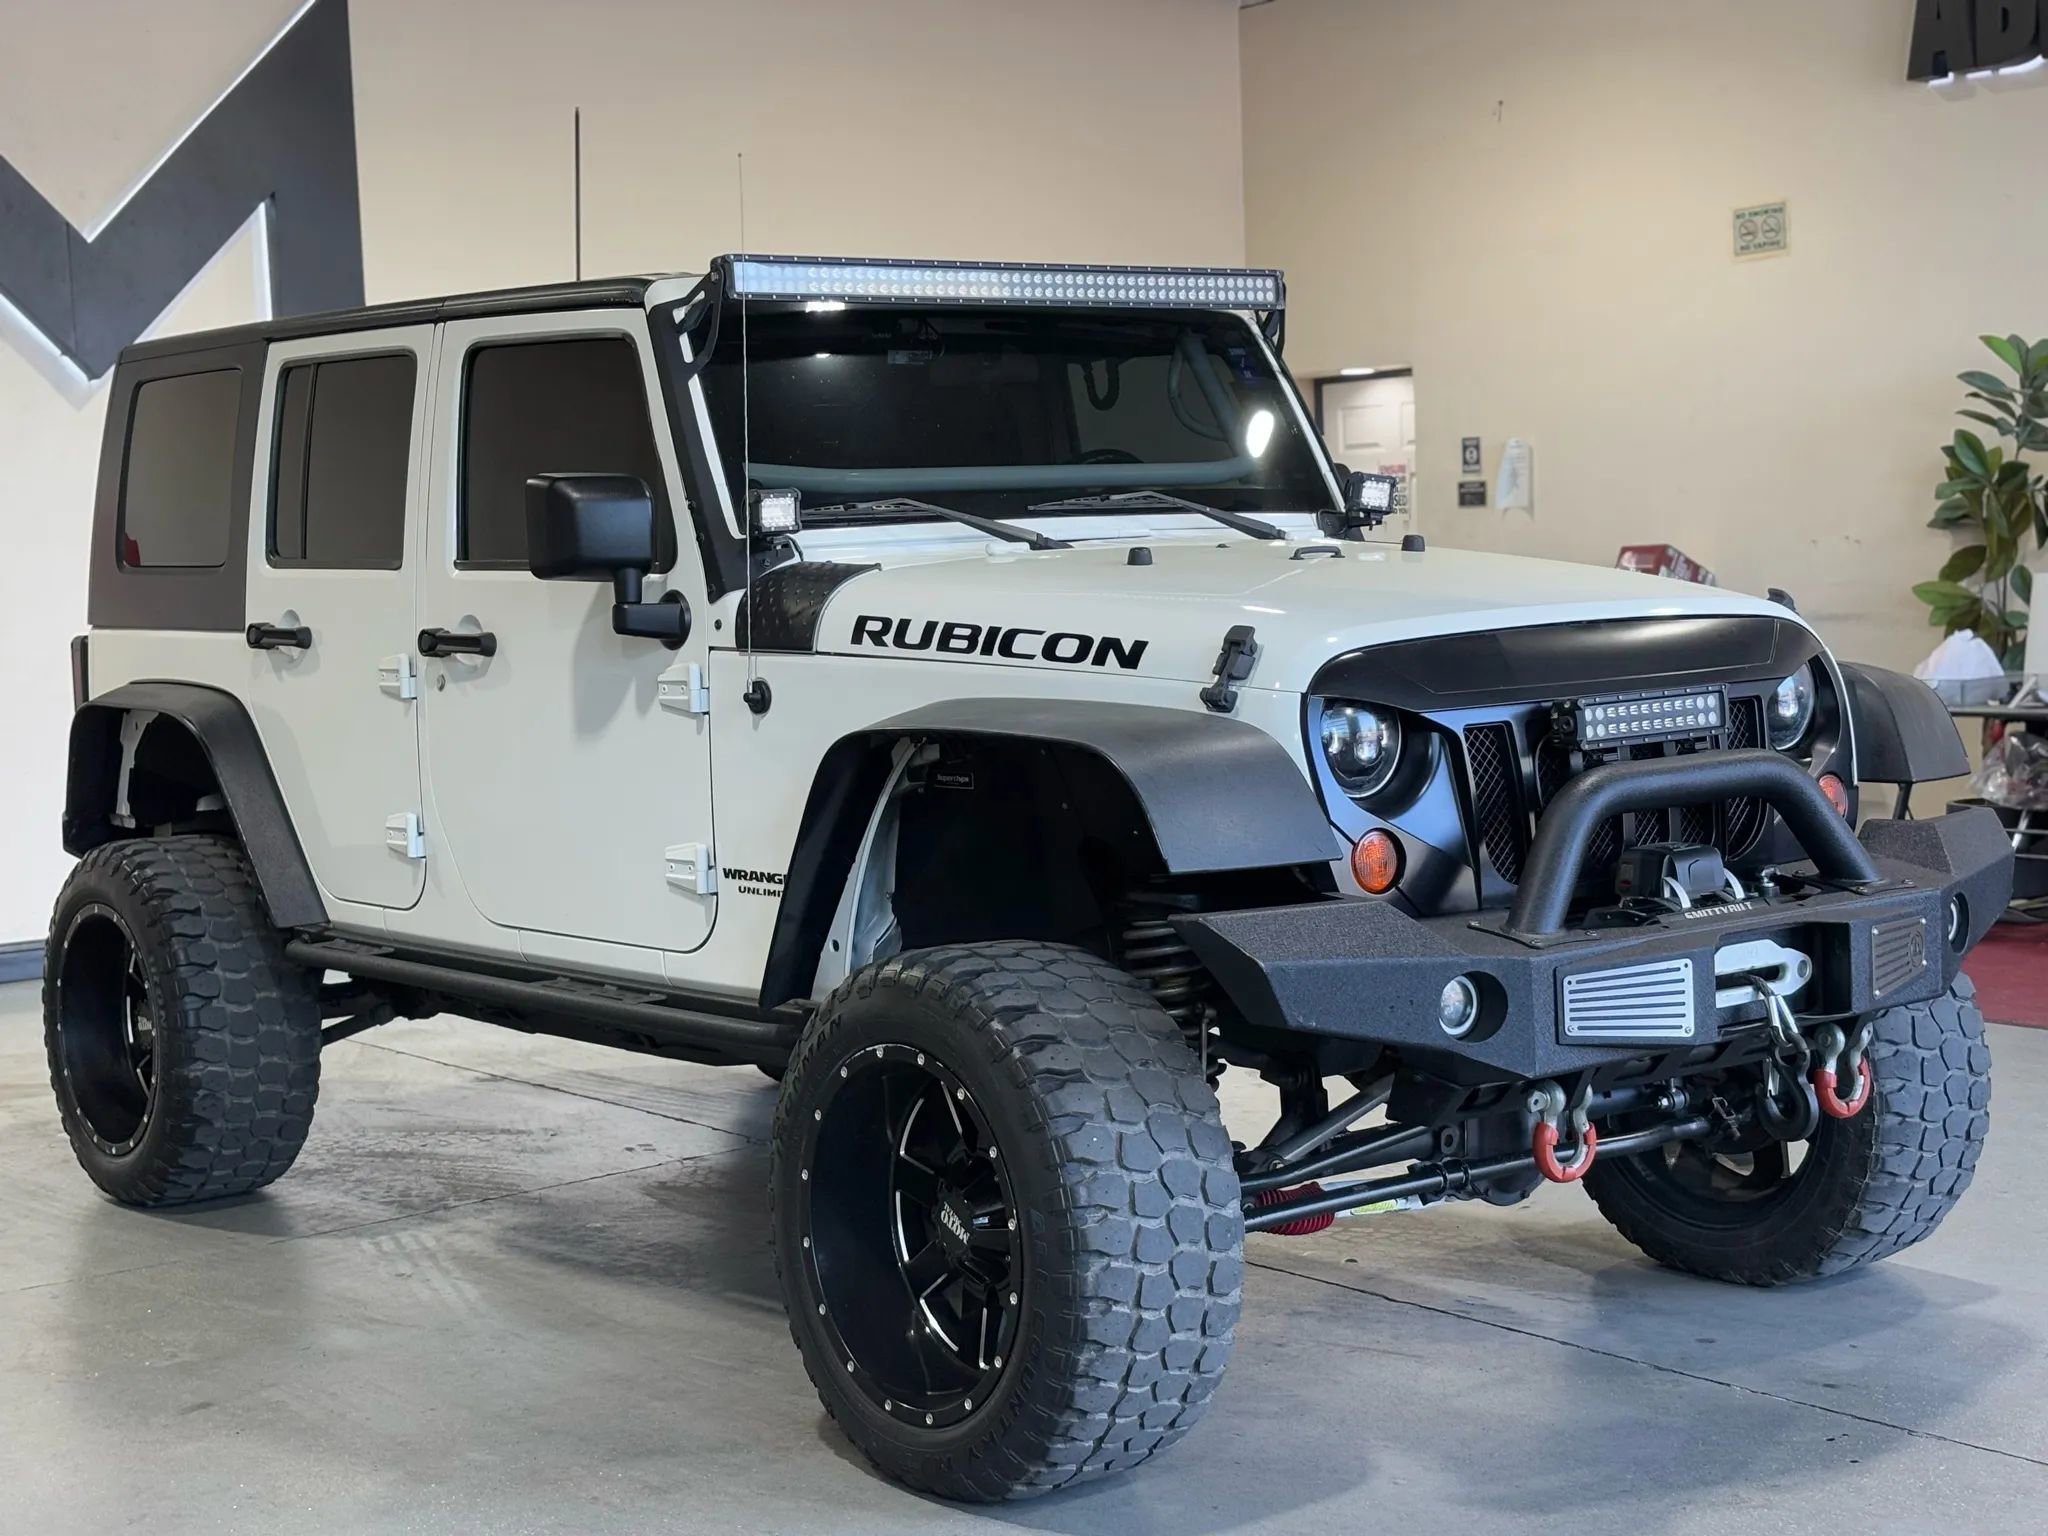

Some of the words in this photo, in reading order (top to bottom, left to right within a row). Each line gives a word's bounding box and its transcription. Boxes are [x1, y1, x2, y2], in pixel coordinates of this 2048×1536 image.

[849, 614, 1149, 671] RUBICON
[722, 867, 787, 885] WRANG
[738, 885, 784, 898] UNLIMI
[940, 1208, 970, 1245] MOTO
